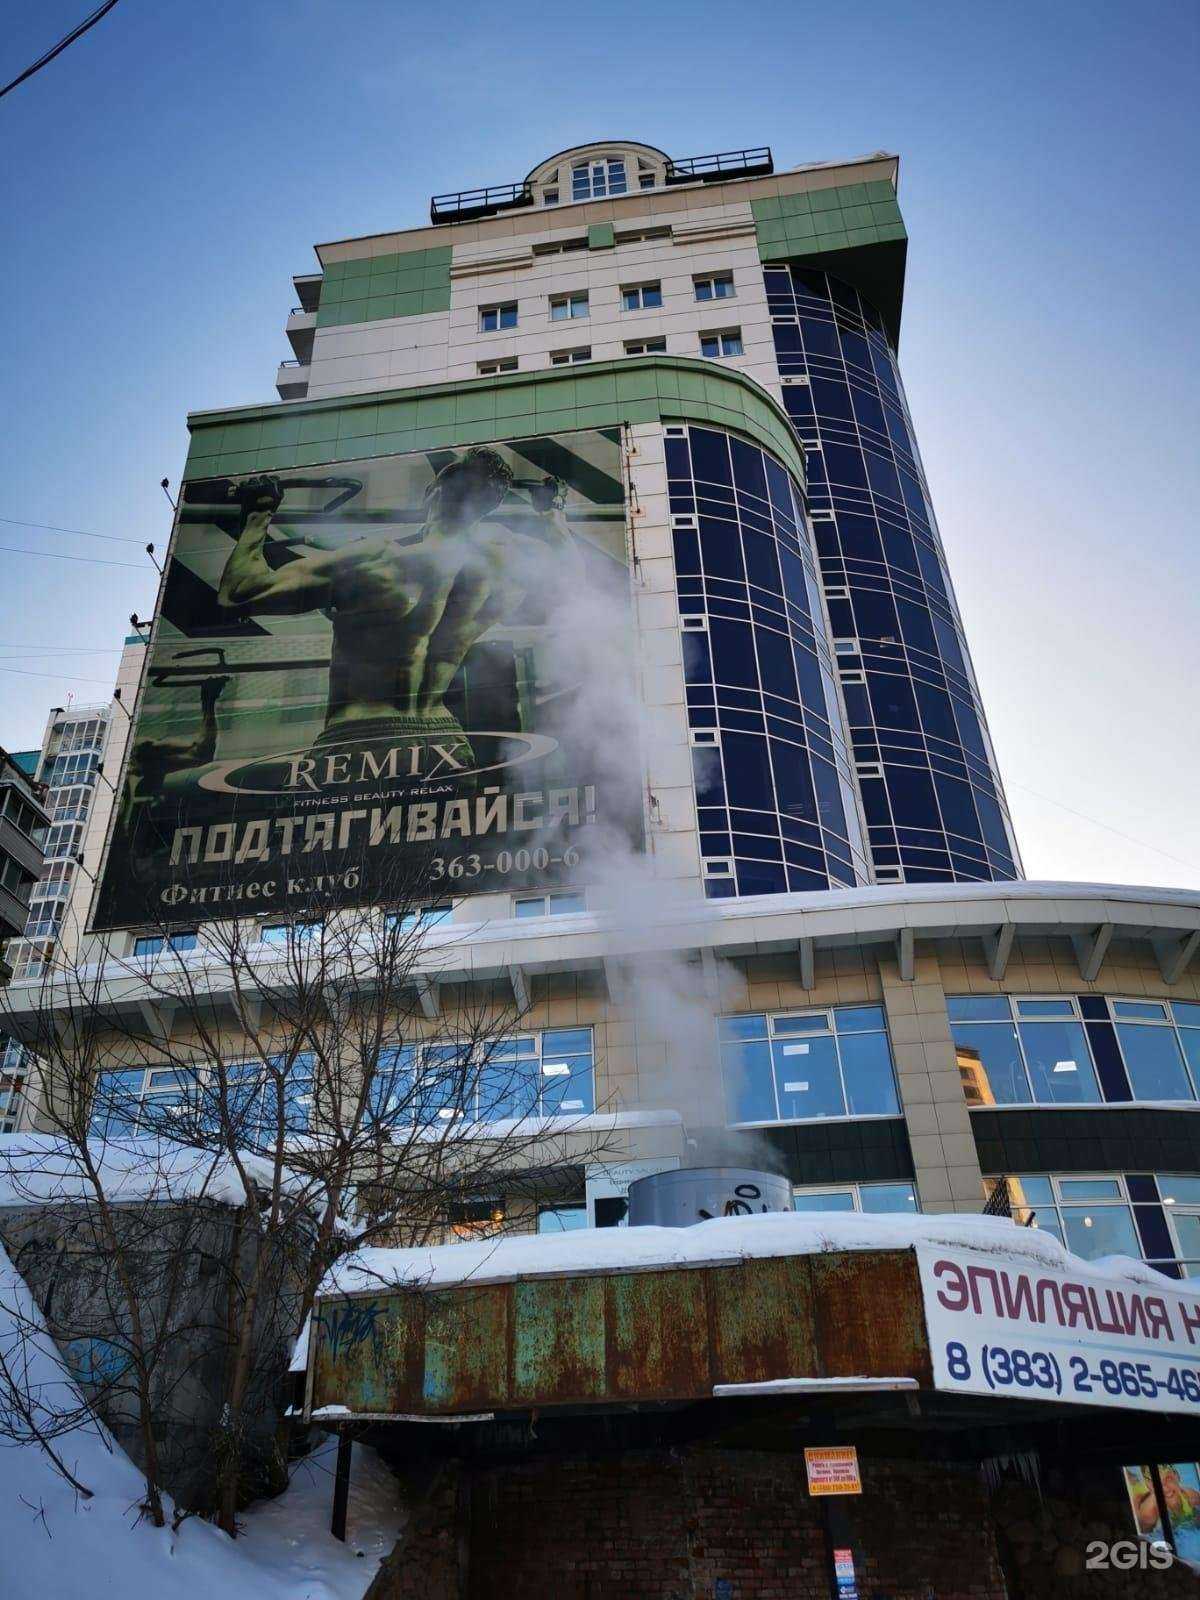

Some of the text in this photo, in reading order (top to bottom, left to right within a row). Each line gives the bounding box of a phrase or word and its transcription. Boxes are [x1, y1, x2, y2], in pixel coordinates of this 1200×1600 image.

[284, 742, 468, 792] REMIX
[294, 784, 454, 807] FITNESS BEAUTY RELAX
[169, 785, 596, 866] ПОДТЯГИВАЙСЯ!
[160, 865, 361, 905] Фитнес клуб
[933, 1260, 1175, 1342] ЭПИЛЯЦИЯ
[946, 1341, 1200, 1402] 8 (383) 2-865-46
